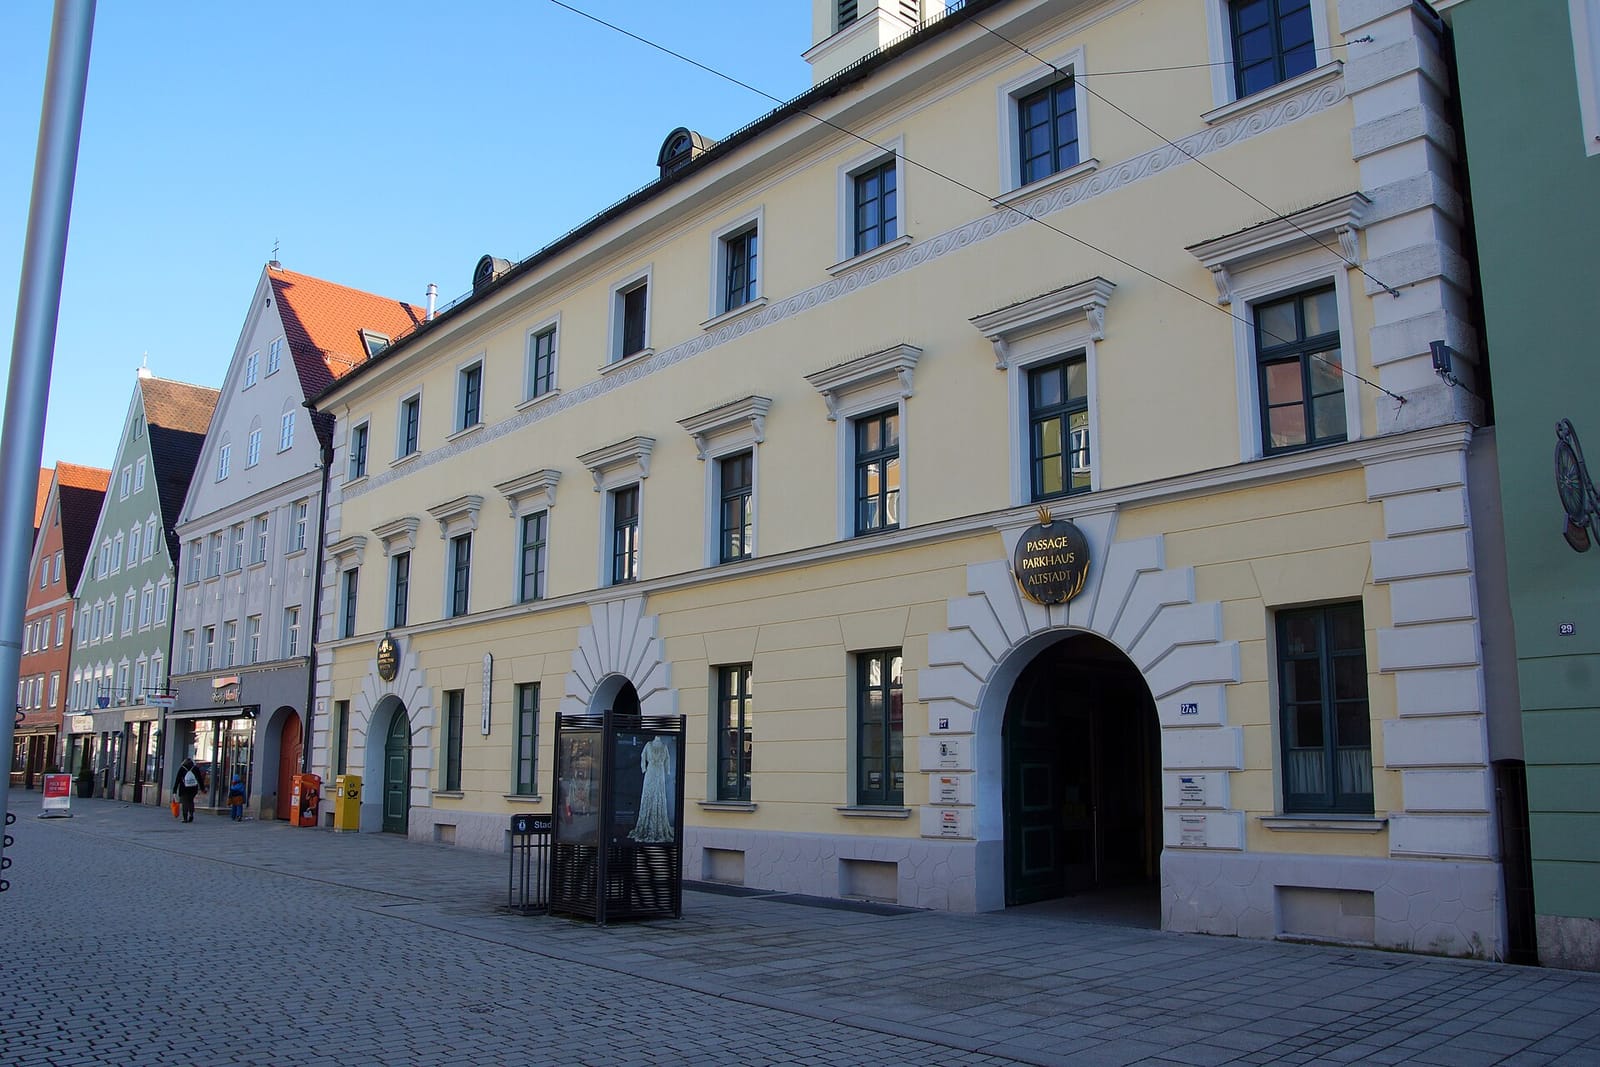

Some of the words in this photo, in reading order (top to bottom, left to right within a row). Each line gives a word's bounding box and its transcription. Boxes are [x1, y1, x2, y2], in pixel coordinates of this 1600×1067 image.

[1026, 536, 1068, 553] PASSAGE
[1022, 552, 1075, 570] PARKHAUS
[1027, 569, 1072, 586] ALTSTADT
[1560, 624, 1573, 633] 29
